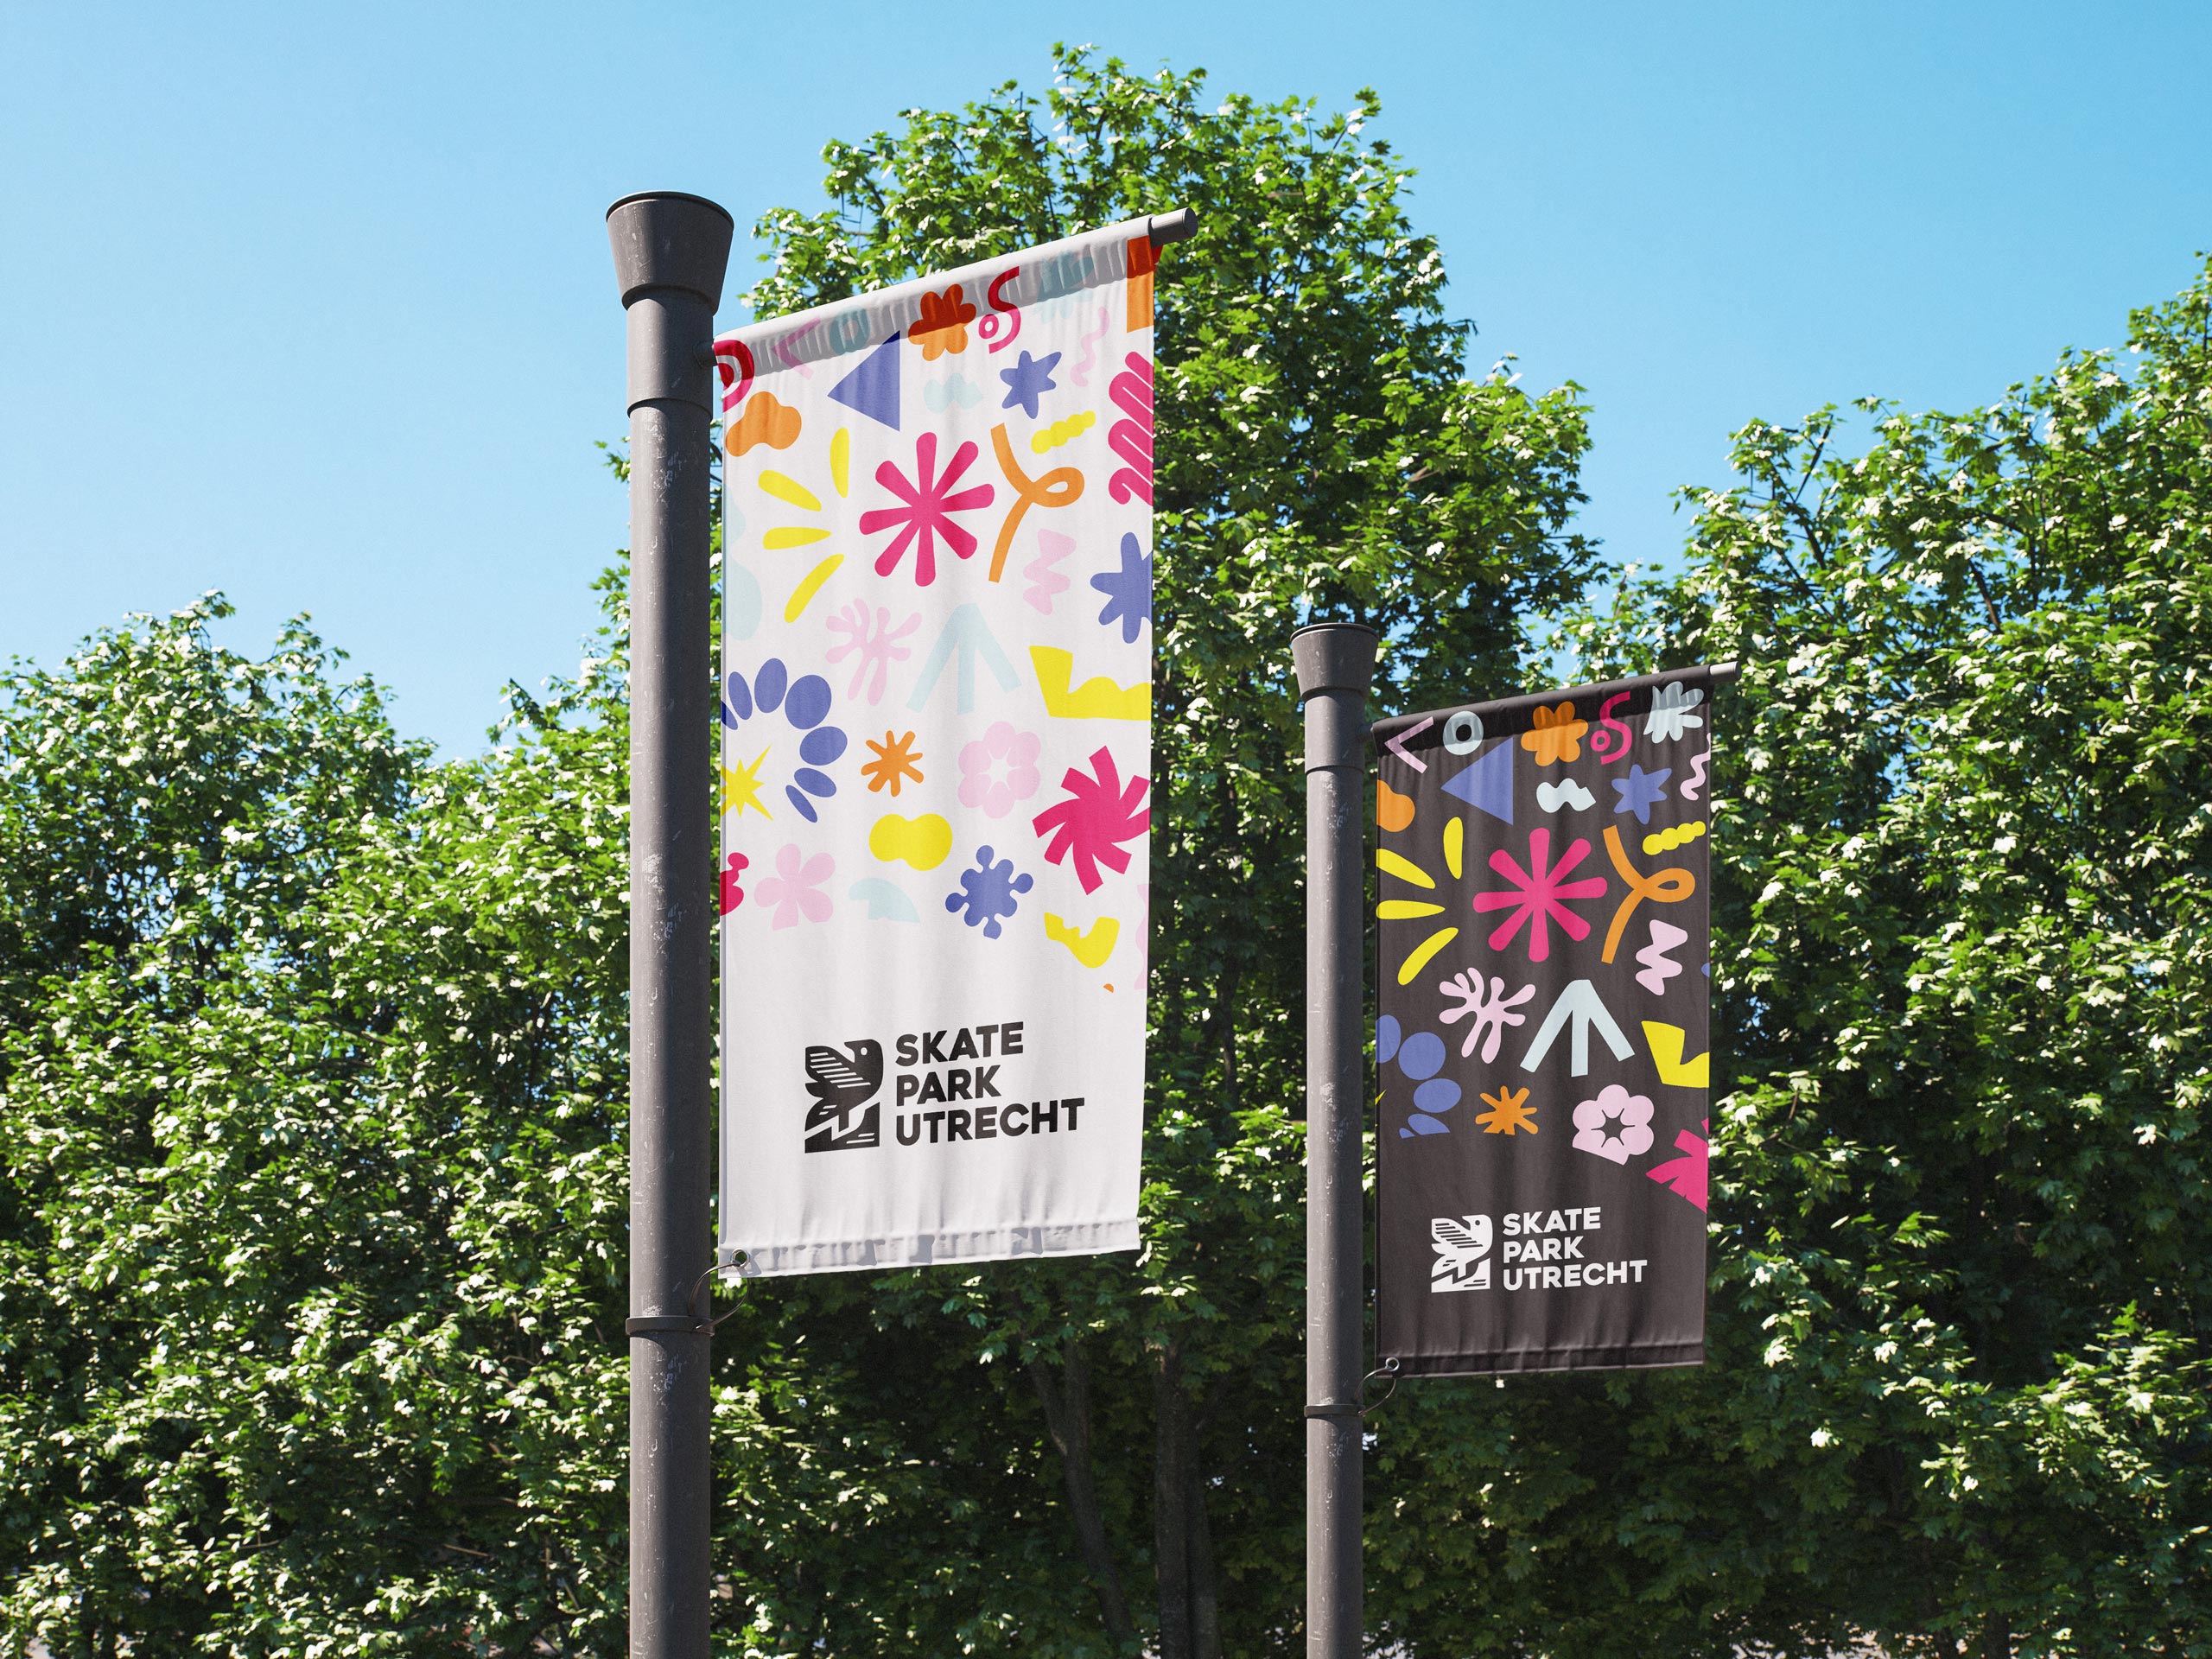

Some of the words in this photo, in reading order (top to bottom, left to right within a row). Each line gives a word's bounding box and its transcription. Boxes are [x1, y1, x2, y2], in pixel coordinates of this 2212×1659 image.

[895, 1020, 1024, 1067] SKATE
[896, 1065, 1001, 1107] PARK
[896, 1097, 1085, 1147] UTRECHT
[1503, 1206, 1601, 1236] SKATE
[1503, 1236, 1585, 1264] PARK
[1503, 1259, 1648, 1291] UTRECHT
